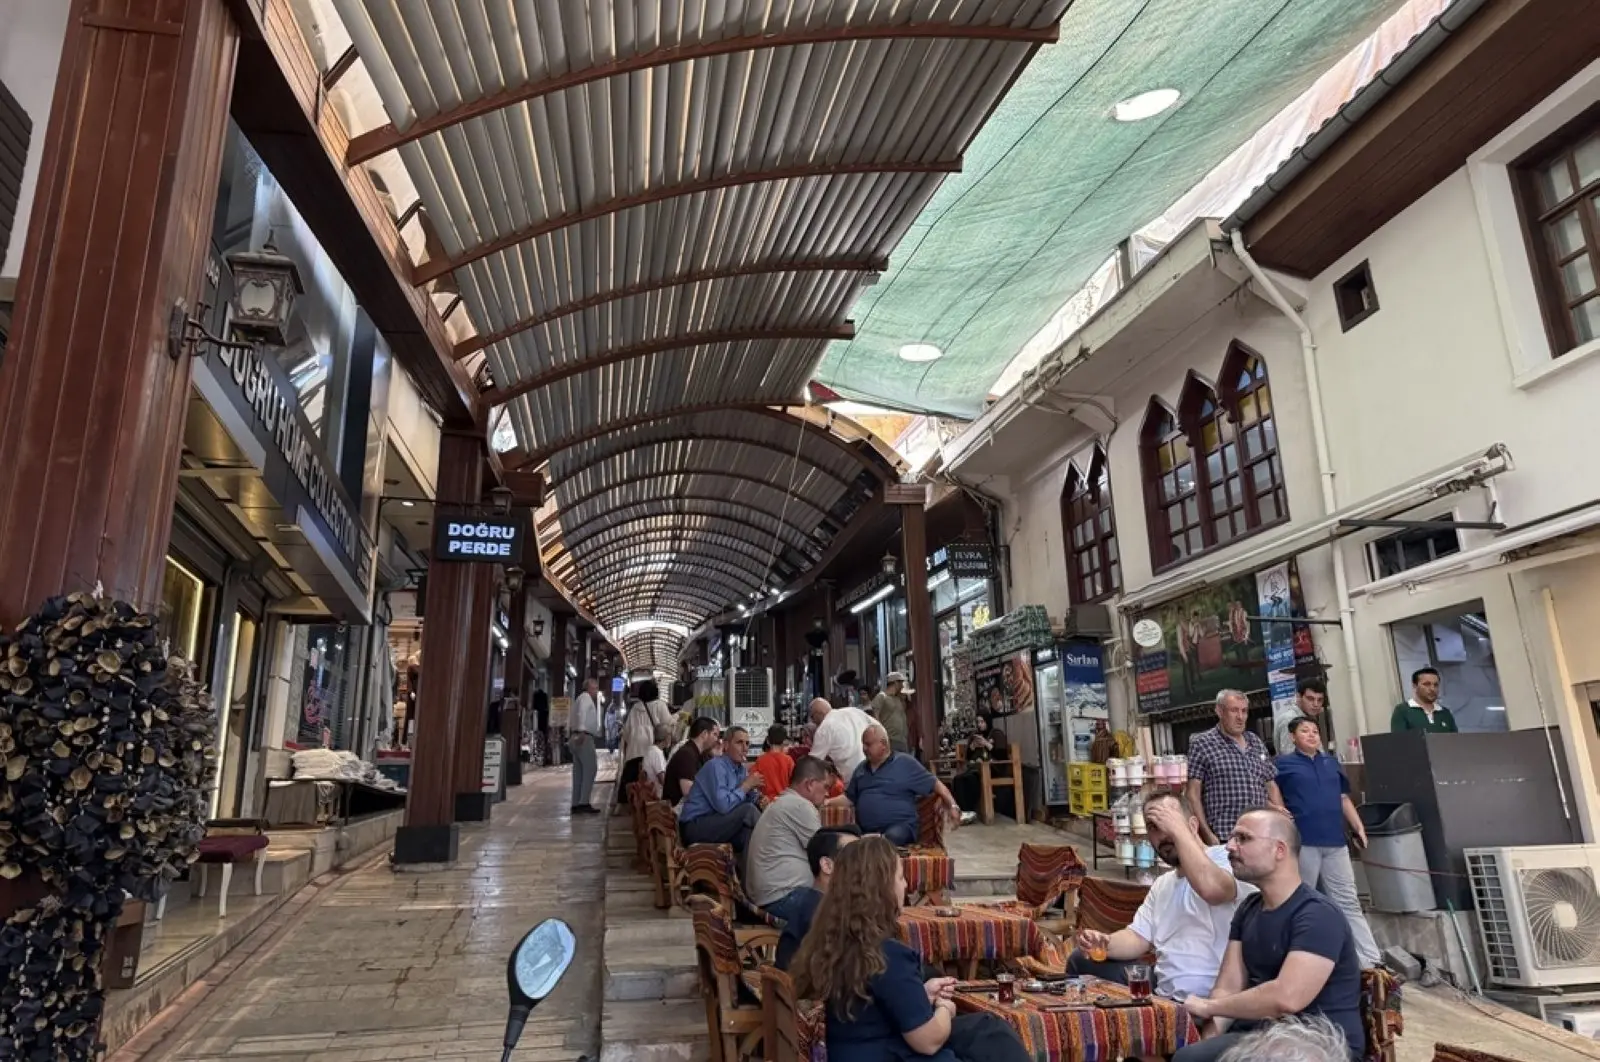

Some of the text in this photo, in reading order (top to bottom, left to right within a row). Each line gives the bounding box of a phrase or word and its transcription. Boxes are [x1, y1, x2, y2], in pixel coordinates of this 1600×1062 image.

[275, 399, 311, 489] HOME
[309, 454, 357, 562] COLLECTION
[448, 522, 515, 539] DOĞRU
[448, 540, 511, 555] PERDE
